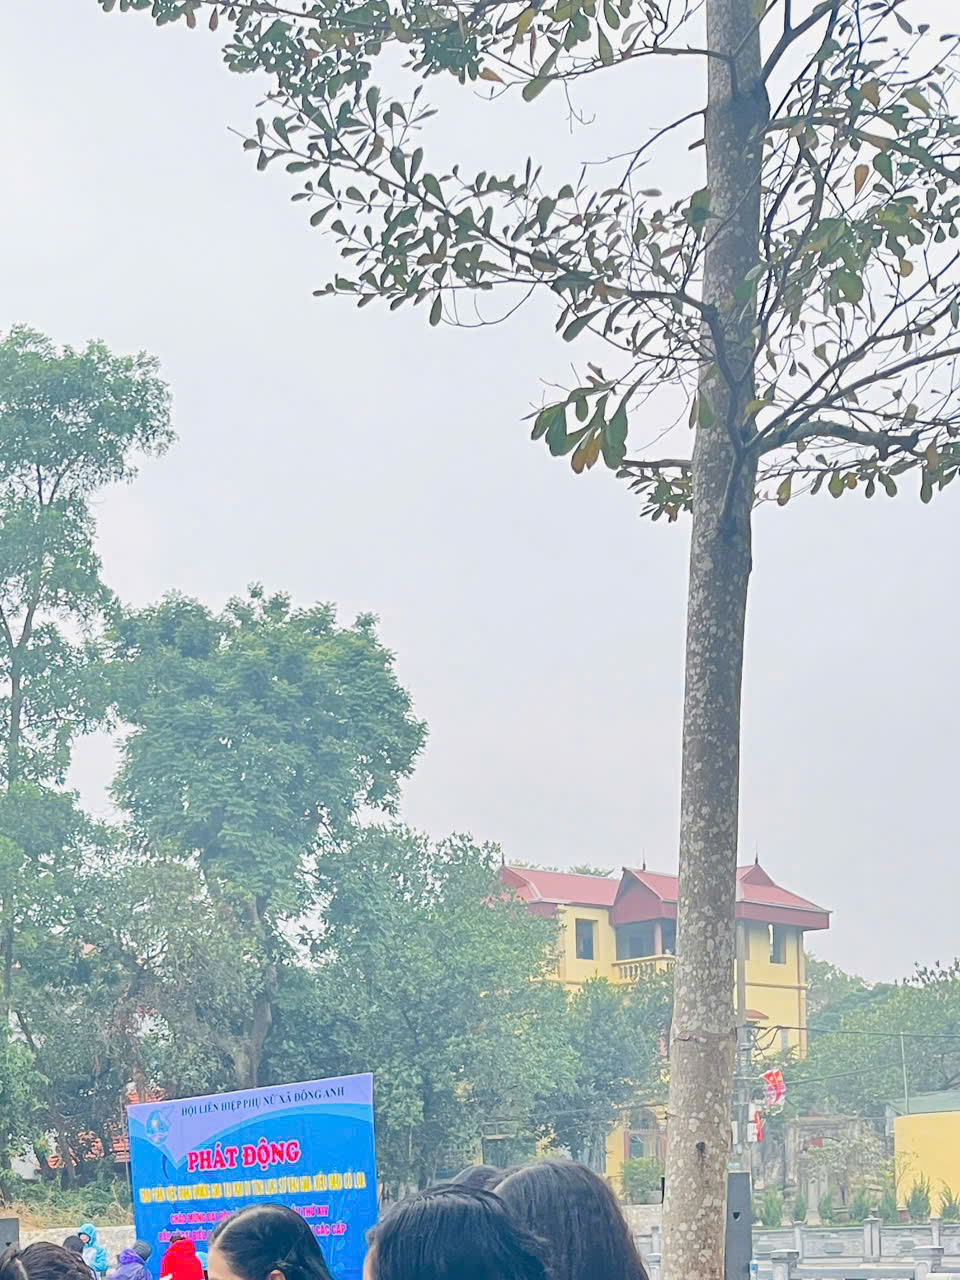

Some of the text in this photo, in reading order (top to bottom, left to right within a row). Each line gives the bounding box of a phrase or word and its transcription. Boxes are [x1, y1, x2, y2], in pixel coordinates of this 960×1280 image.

[221, 1100, 242, 1112] HIỆP
[243, 1097, 261, 1109] PHỤ
[324, 1087, 345, 1099] ANH
[187, 1136, 301, 1172] PHÁT ĐỘNG
